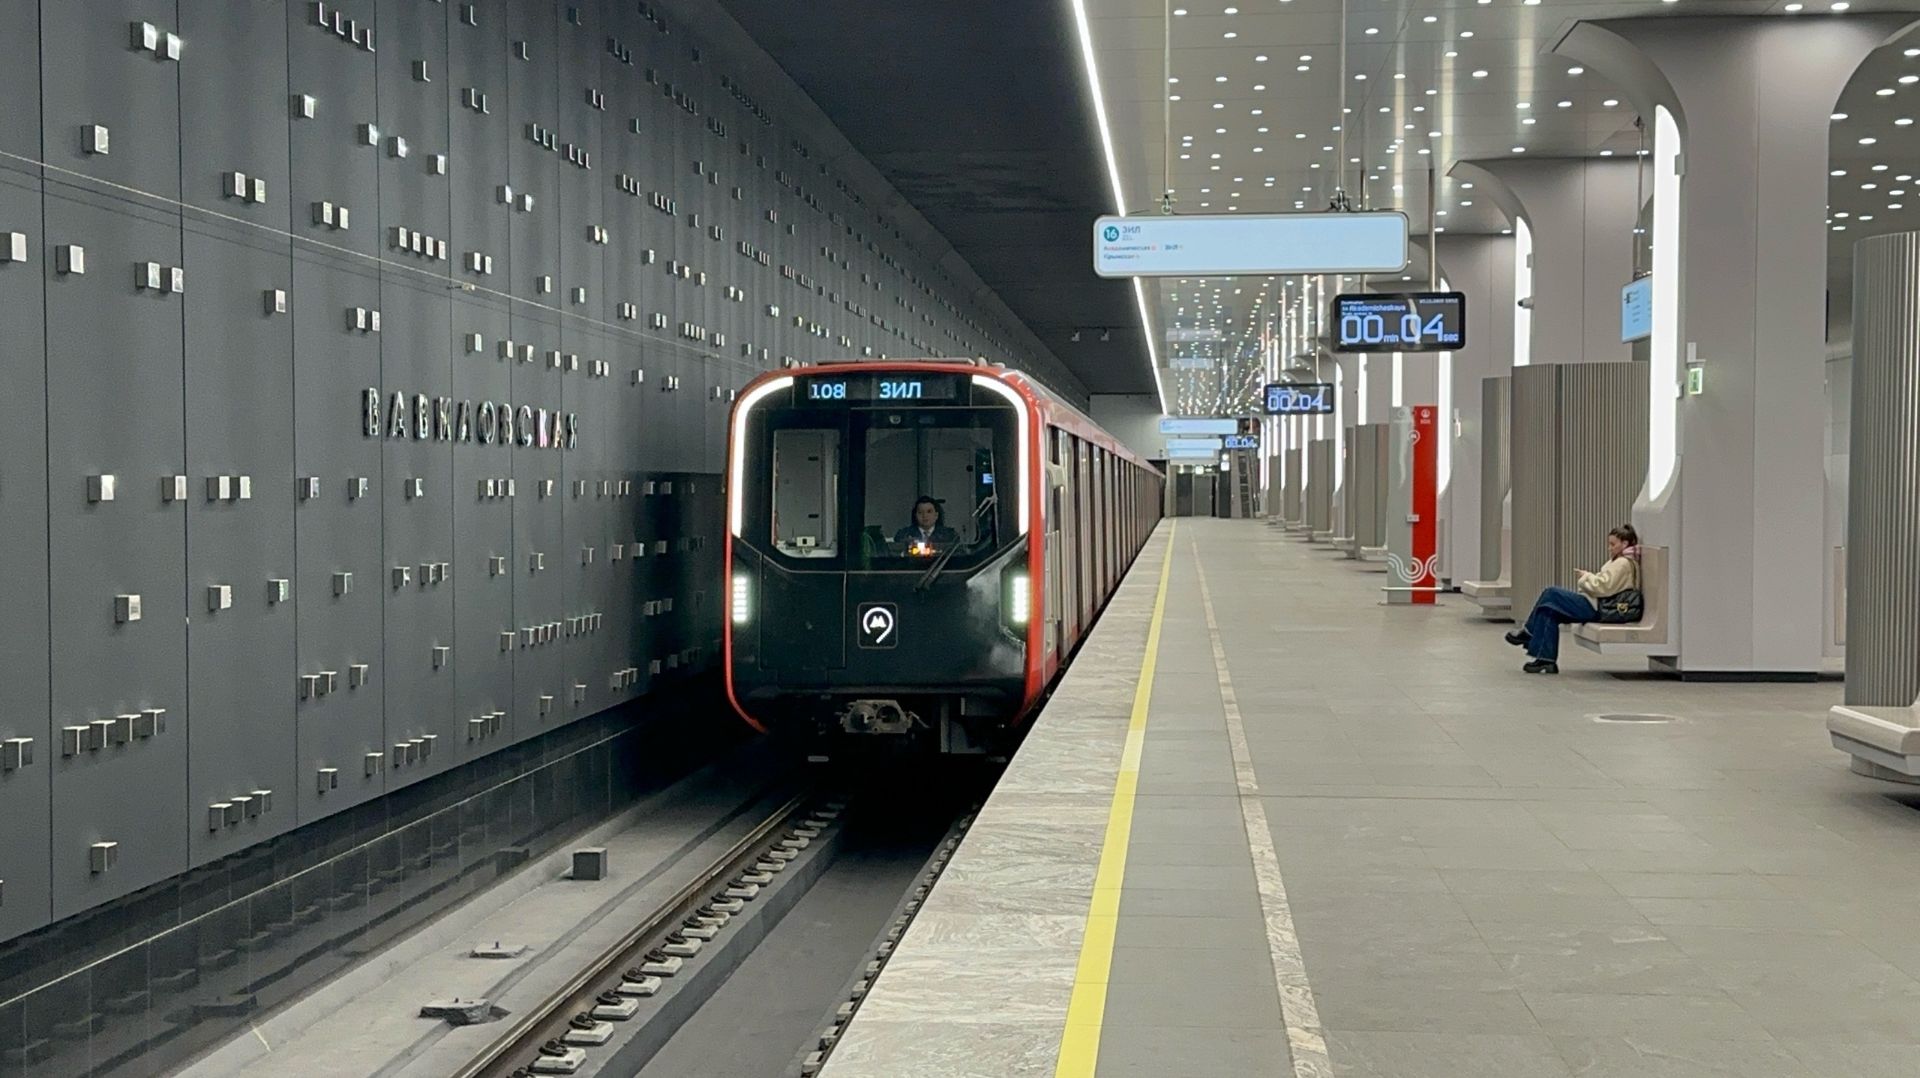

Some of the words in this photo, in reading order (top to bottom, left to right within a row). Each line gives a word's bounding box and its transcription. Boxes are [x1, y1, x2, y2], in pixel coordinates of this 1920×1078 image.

[1105, 228, 1118, 240] 16
[1122, 226, 1141, 234] ЗИЛ
[1341, 314, 1384, 343] 00
[1384, 334, 1399, 343] min
[1401, 313, 1443, 342] 04
[1444, 333, 1458, 342] sec
[811, 383, 844, 398] 108
[879, 382, 922, 399] ЗИЛ
[1268, 395, 1291, 411] 00
[1300, 394, 1323, 411] 04
[363, 387, 578, 449] ВАВИЛОВСКАЯ
